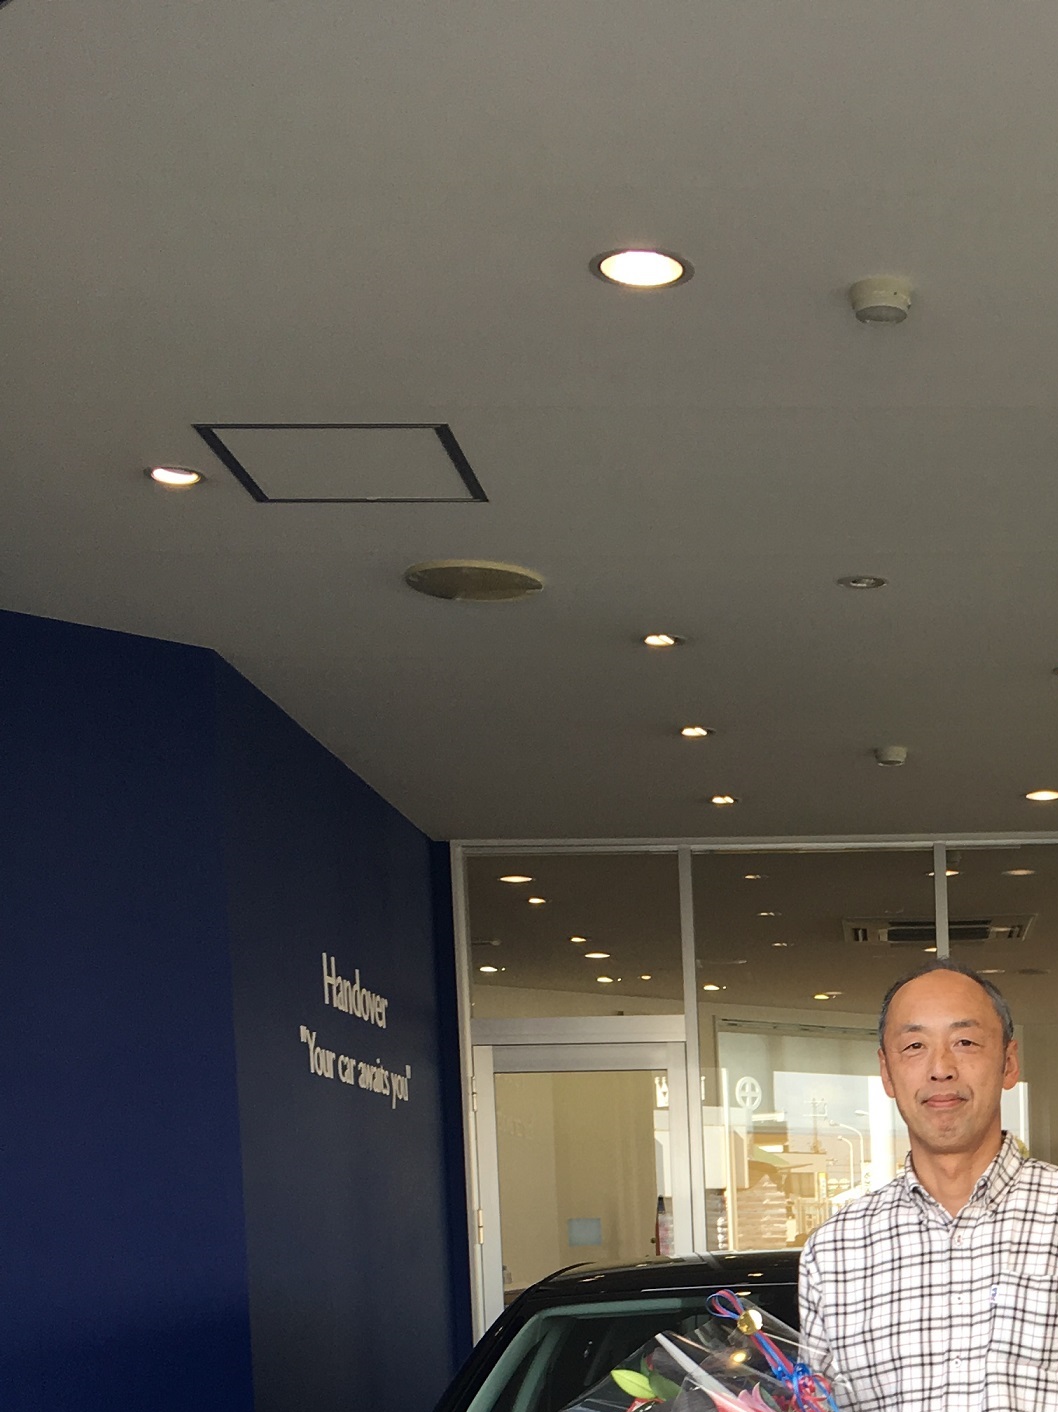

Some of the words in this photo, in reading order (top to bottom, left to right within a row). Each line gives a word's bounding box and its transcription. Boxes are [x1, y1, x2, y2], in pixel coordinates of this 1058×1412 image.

[322, 952, 388, 1029] Handover
[338, 1054, 355, 1085] car
[358, 1058, 390, 1096] awaits
